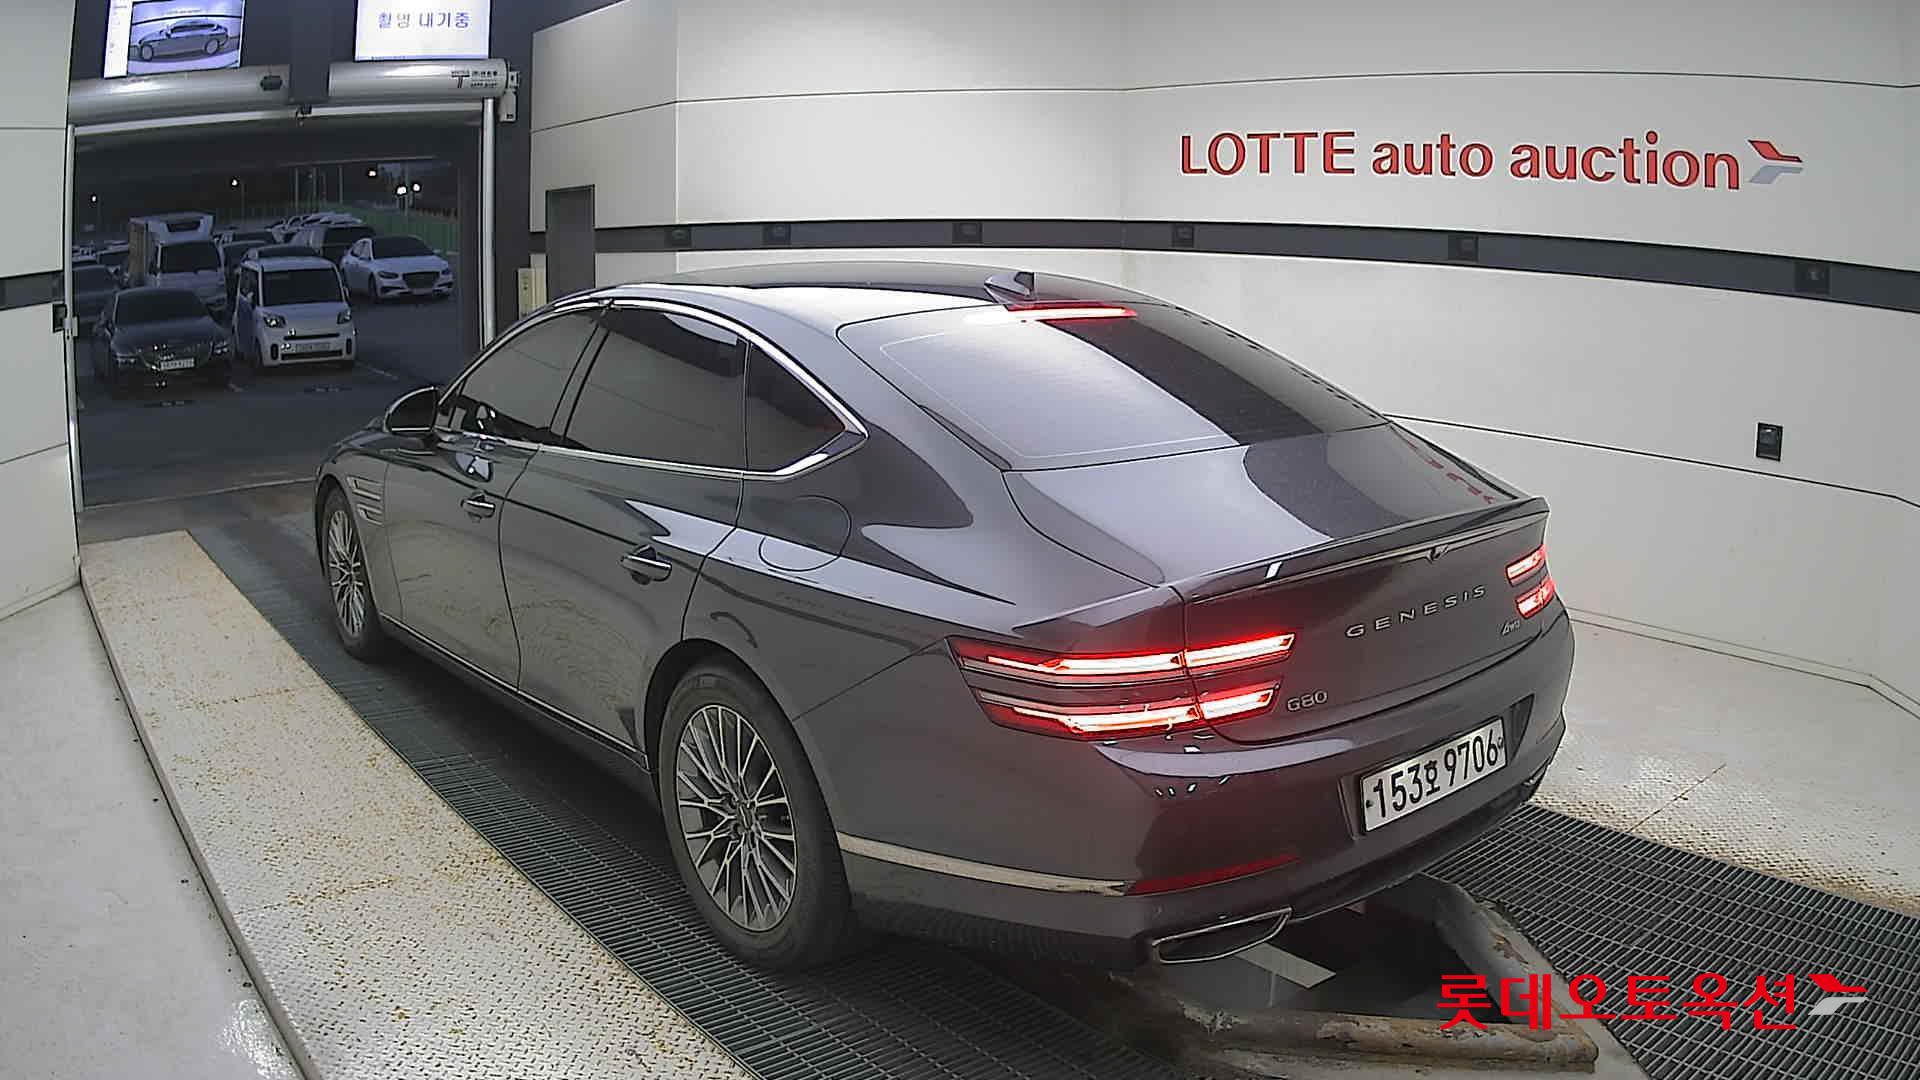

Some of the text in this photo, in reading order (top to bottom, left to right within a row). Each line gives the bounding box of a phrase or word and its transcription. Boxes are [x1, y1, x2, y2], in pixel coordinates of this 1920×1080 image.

[1180, 130, 1740, 190] LOTTE auto auction
[1345, 584, 1486, 638] GENESIS
[1287, 690, 1328, 711] G80
